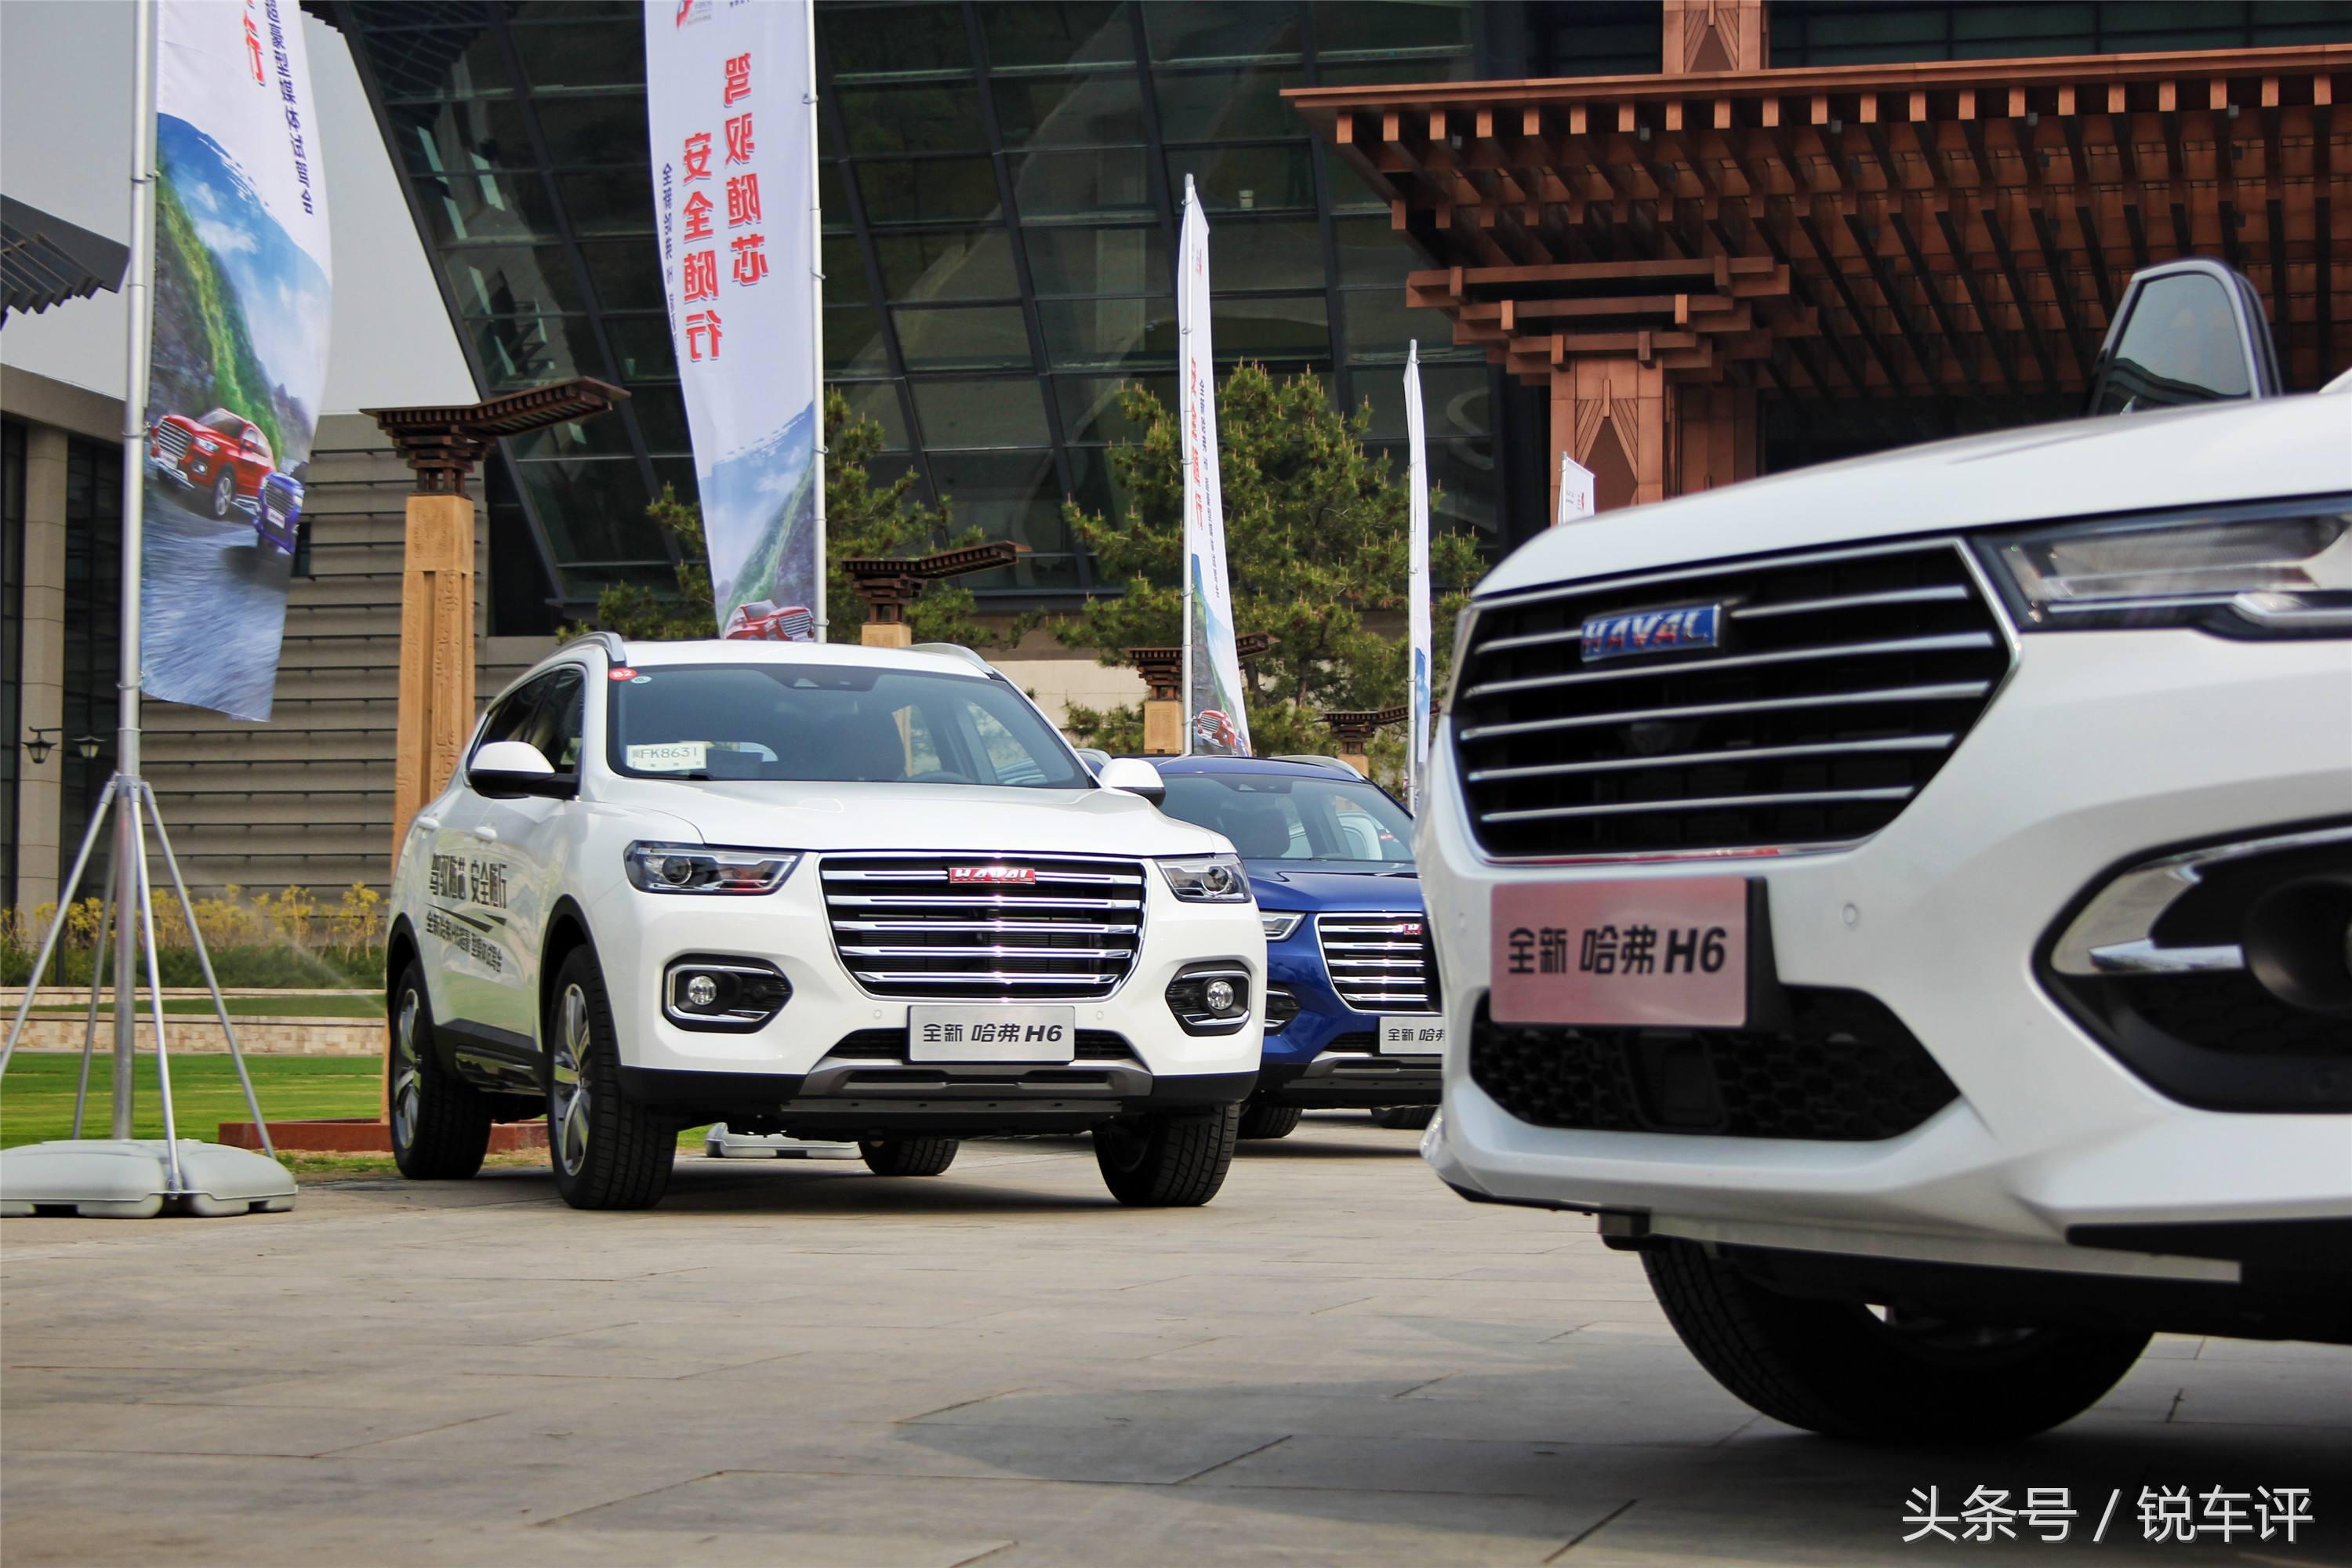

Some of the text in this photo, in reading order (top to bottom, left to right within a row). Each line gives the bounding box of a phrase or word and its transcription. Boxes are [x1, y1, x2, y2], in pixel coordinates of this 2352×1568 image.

[1581, 611, 1709, 654] HAVAL
[1508, 927, 1568, 975] 全新
[923, 1023, 964, 1043] 全新
